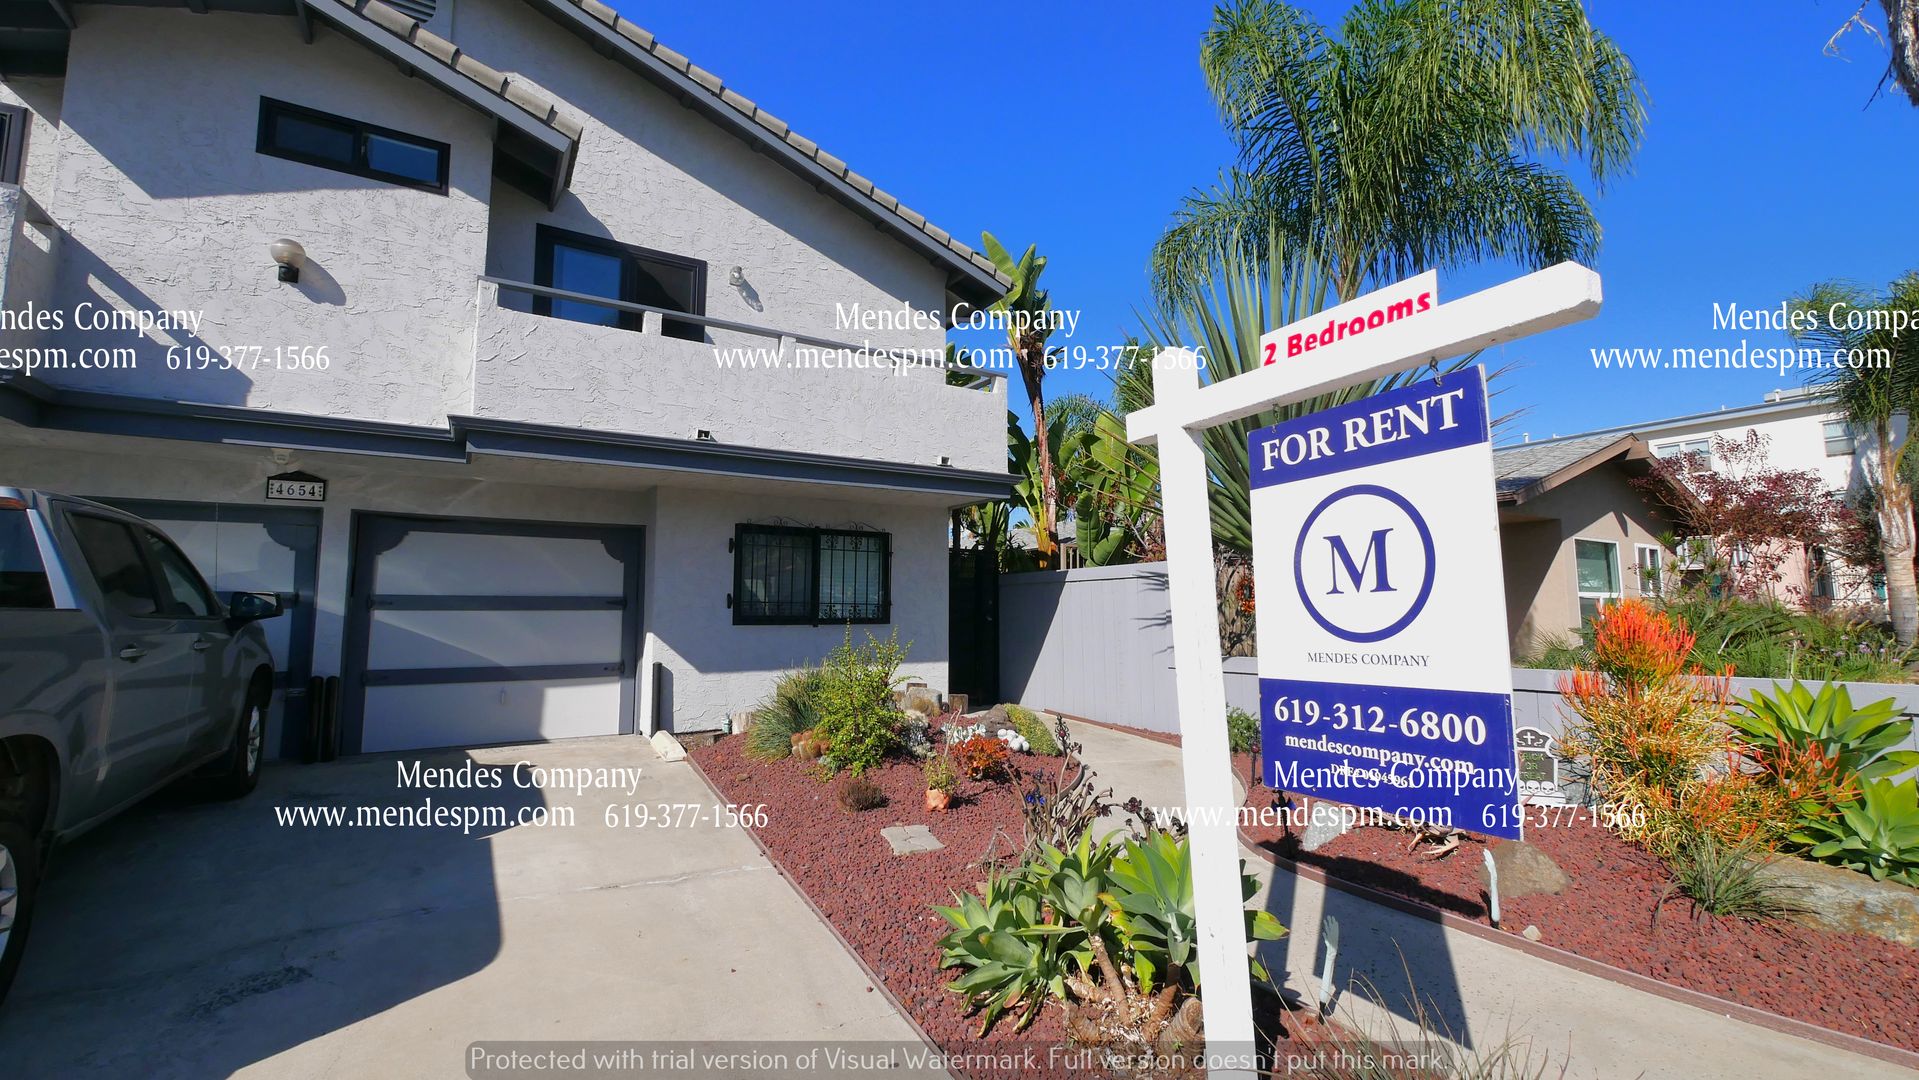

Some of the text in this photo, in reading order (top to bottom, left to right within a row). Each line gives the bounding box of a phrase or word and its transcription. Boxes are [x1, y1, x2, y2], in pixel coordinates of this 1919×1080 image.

[1263, 292, 1431, 367] 2 Bedrooms
[1261, 388, 1464, 472] FOR RENT
[276, 483, 316, 497] 4654
[1323, 527, 1398, 595] M
[1307, 652, 1430, 667] MENDES COMPANY
[1273, 695, 1487, 746] 619-312-6800
[1284, 732, 1476, 777] mendescompany.com
